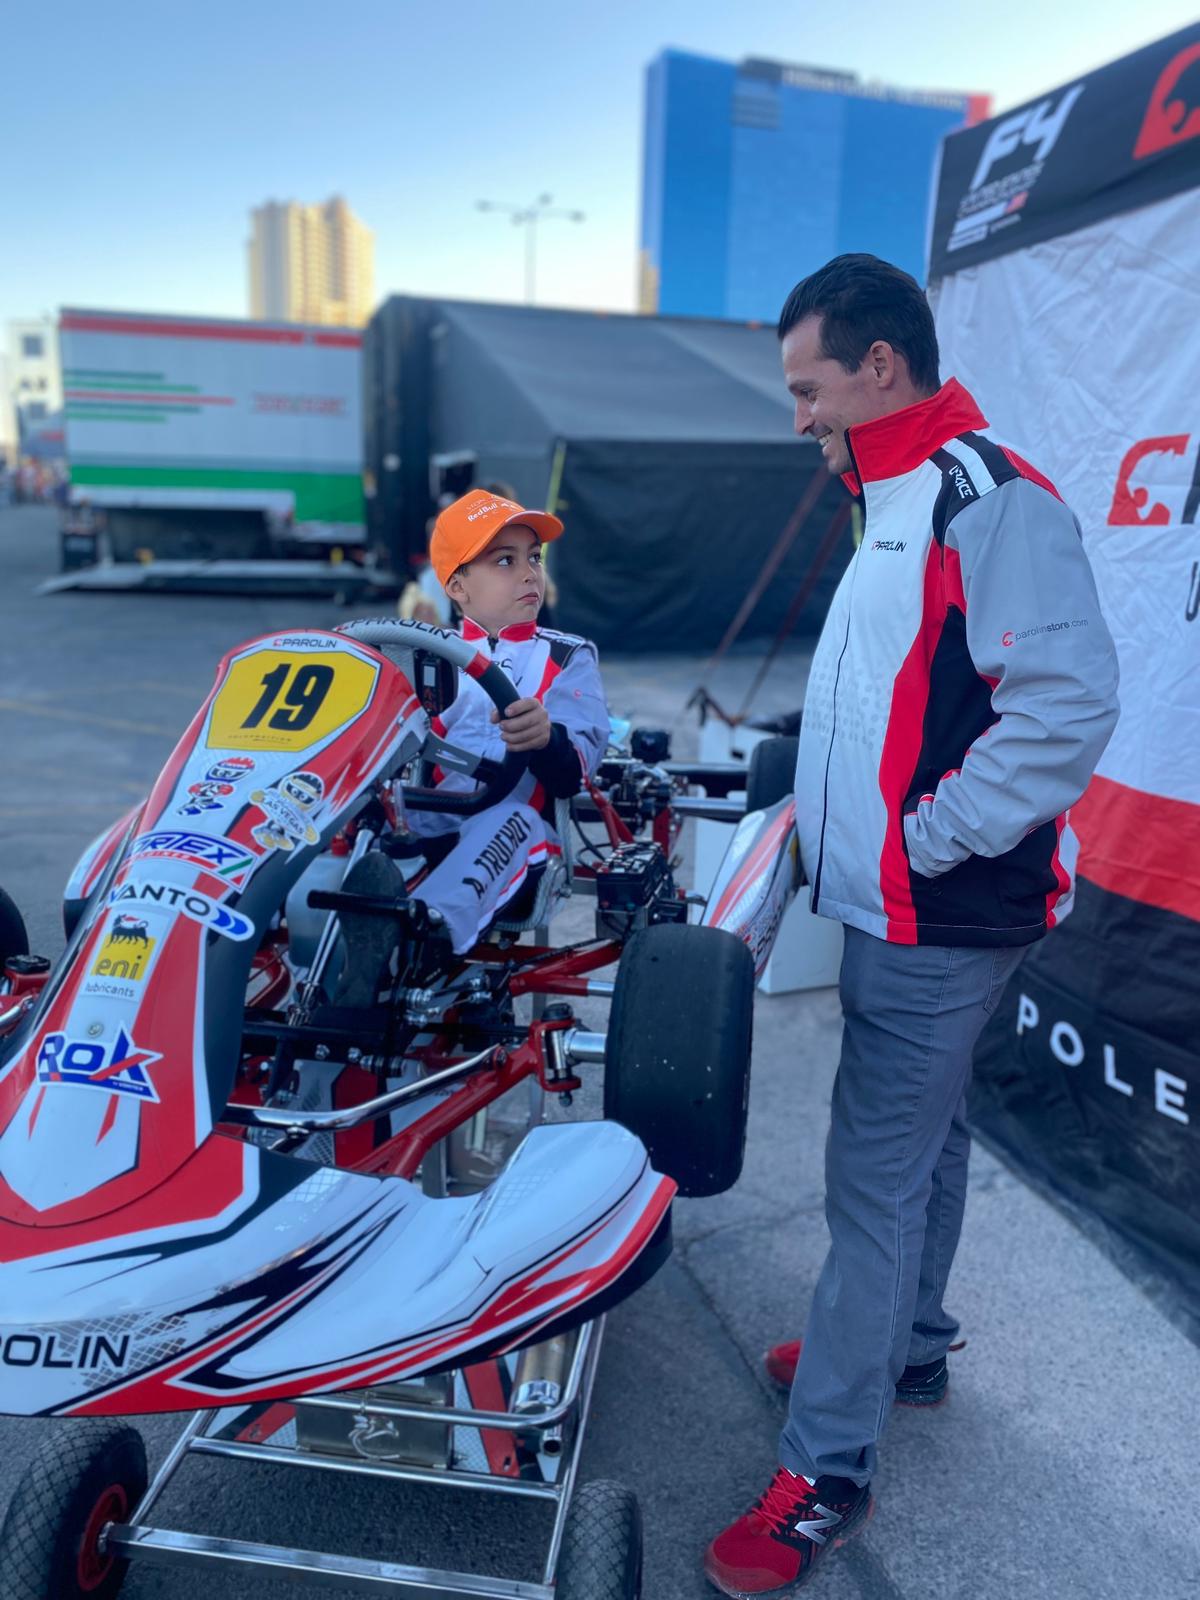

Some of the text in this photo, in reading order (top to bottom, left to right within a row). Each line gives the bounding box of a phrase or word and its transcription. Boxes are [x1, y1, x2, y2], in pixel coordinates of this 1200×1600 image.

[968, 83, 1085, 193] F4
[281, 638, 337, 649] PAROLIN
[1015, 619, 1089, 641] parolinstore.com
[240, 663, 335, 731] 19
[132, 835, 240, 864] RTEX
[473, 811, 531, 882] TRUCHOT
[96, 954, 140, 980] eni
[85, 981, 134, 997] lubricants
[1016, 993, 1190, 1125] POLE
[0, 1334, 130, 1368] OLIN
